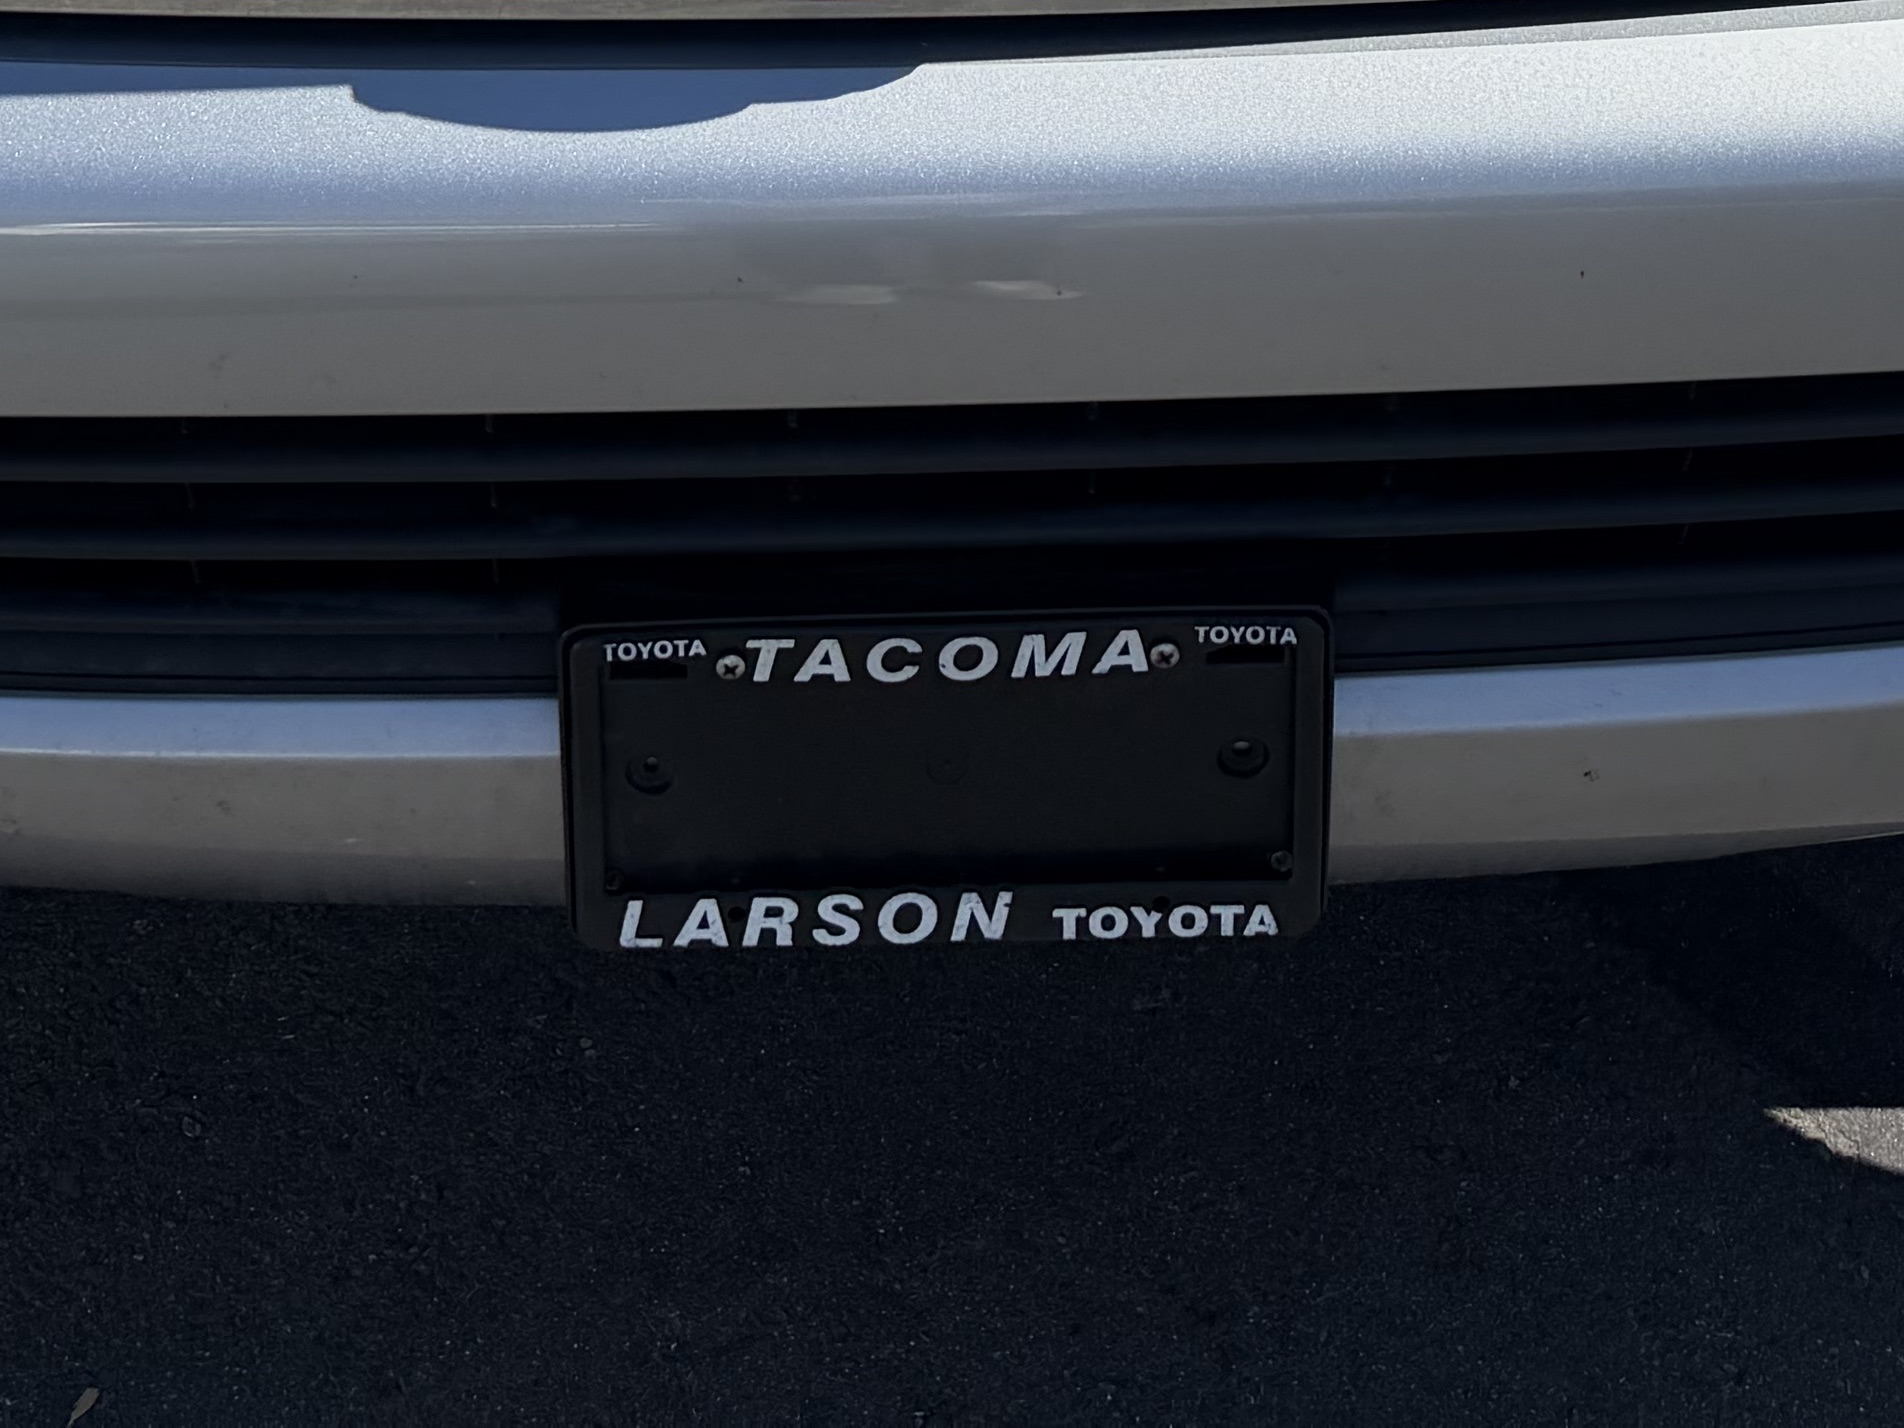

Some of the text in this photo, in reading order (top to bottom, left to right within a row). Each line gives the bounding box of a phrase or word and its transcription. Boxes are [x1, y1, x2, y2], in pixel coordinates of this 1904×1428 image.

[604, 639, 708, 662] TOYOTA
[1194, 624, 1298, 646] TOYOTA
[744, 628, 1150, 683] TACOMA
[618, 890, 1279, 948] LARSON TOYOTA
